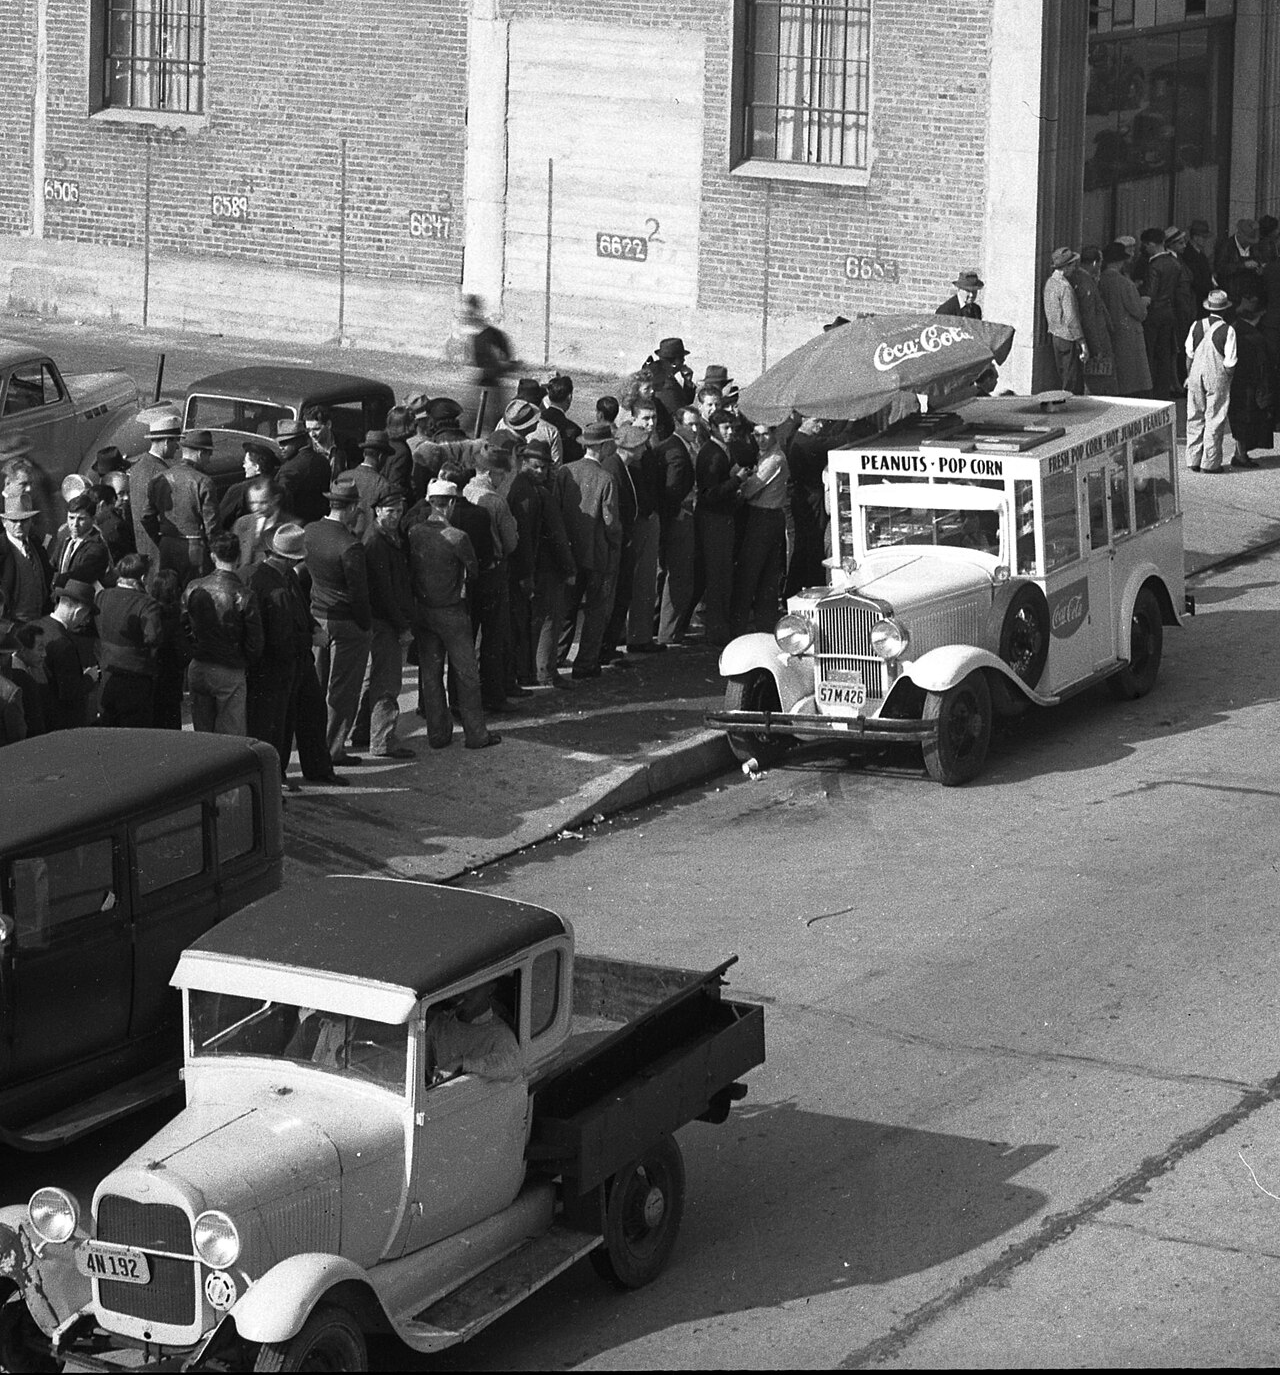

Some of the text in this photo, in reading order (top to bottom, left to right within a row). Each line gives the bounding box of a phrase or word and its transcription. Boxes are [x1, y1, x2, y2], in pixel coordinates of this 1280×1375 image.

[43, 180, 79, 202] 6505
[212, 195, 248, 219] 6589
[644, 217, 666, 243] 2
[873, 323, 974, 372] Coca-Cola
[1048, 408, 1170, 473] FRESH POP CORN HOT JUMBO PEANUTS
[861, 455, 1003, 476] PEANUTS POP CORN
